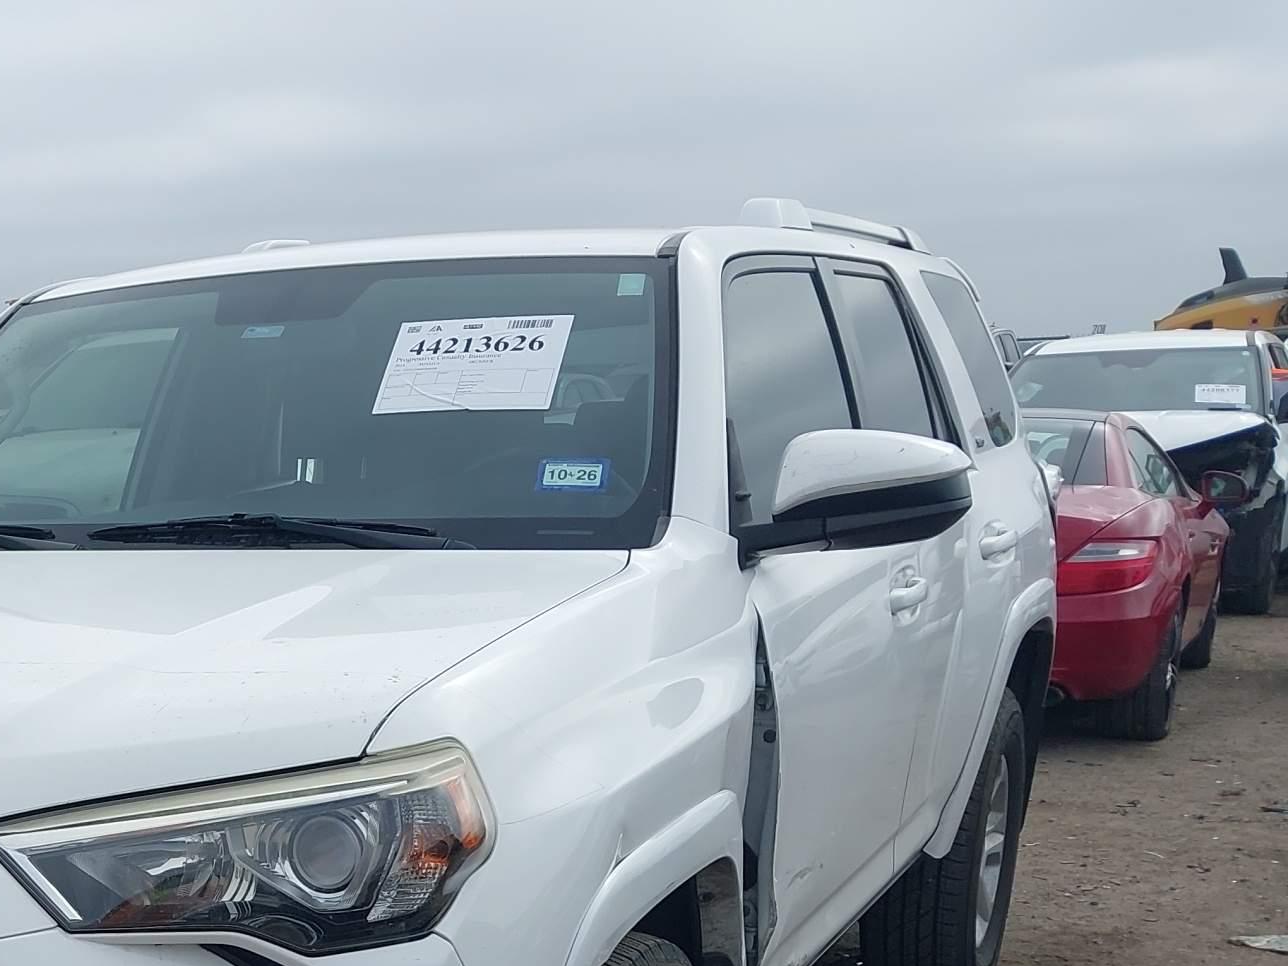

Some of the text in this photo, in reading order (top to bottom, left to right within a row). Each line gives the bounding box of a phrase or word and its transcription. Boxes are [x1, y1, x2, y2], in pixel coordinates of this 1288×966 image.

[409, 334, 546, 356] 44213626
[468, 352, 502, 360] Insurance
[576, 469, 598, 481] 26
